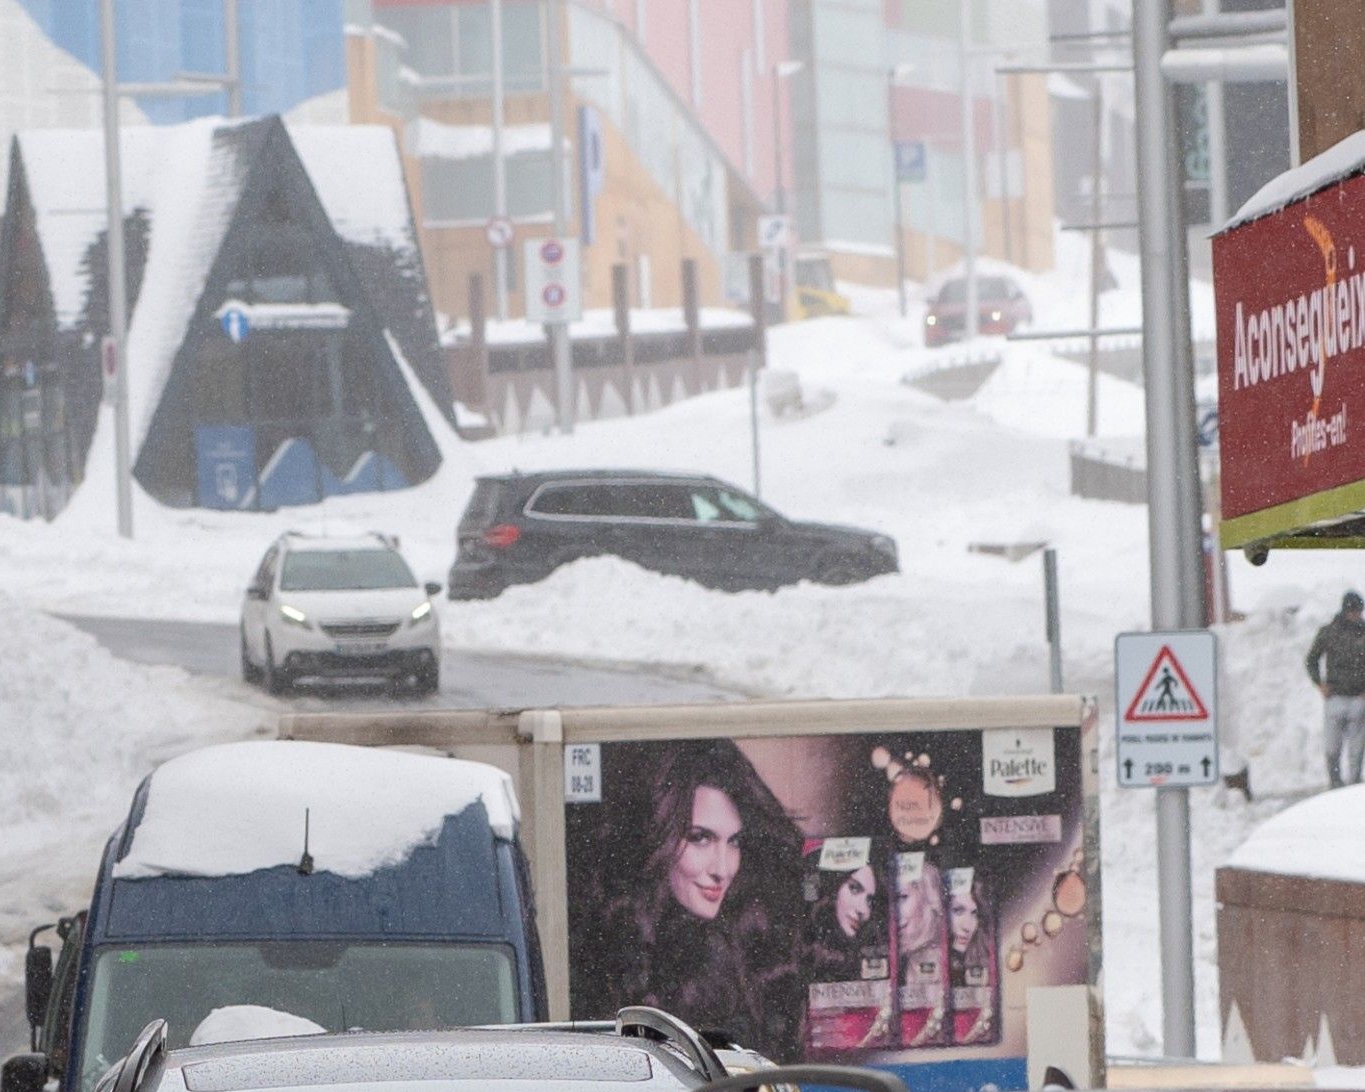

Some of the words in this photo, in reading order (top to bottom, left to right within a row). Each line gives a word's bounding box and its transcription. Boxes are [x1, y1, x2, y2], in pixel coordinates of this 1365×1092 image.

[990, 757, 1048, 777] Palette
[1145, 762, 1172, 776] 200
[984, 817, 1049, 834] INTENSIVE
